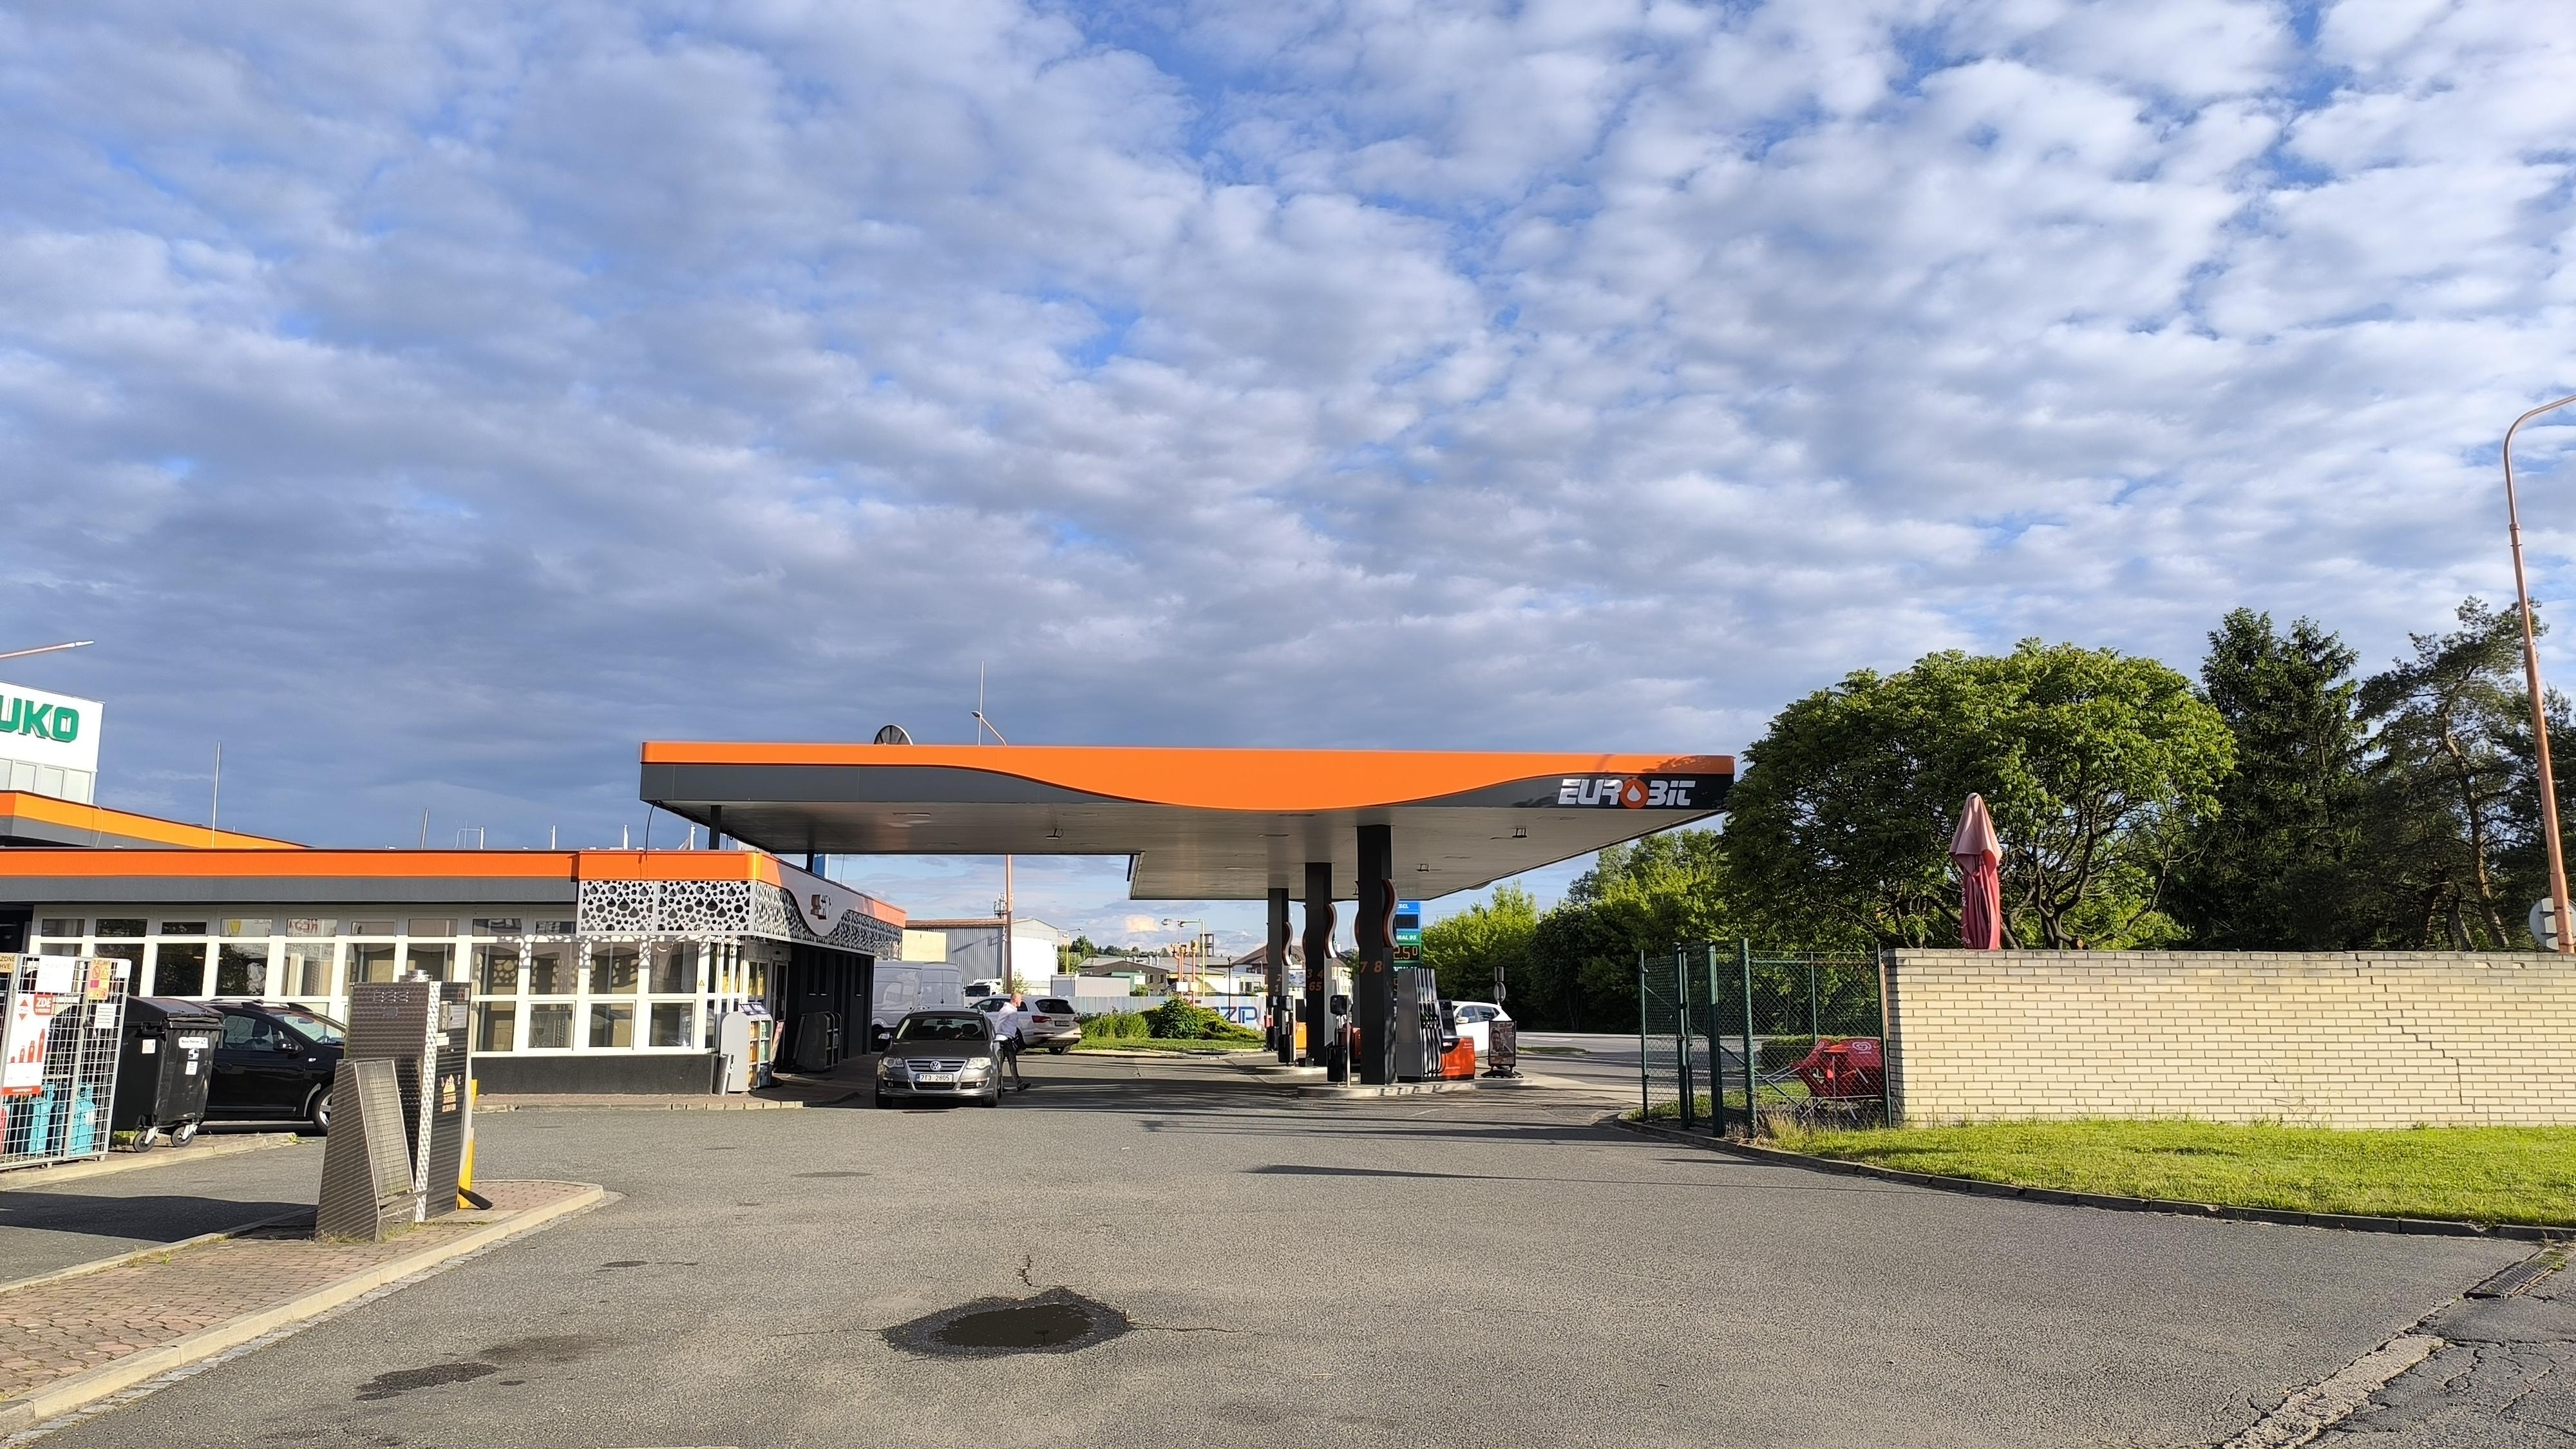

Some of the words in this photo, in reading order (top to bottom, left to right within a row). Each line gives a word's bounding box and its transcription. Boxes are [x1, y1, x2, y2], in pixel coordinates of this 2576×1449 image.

[0, 695, 79, 743] UKO
[1359, 961, 1368, 973] 7
[1374, 960, 1383, 973] 8
[1307, 969, 1313, 978] 3
[36, 997, 52, 1008] ZDE
